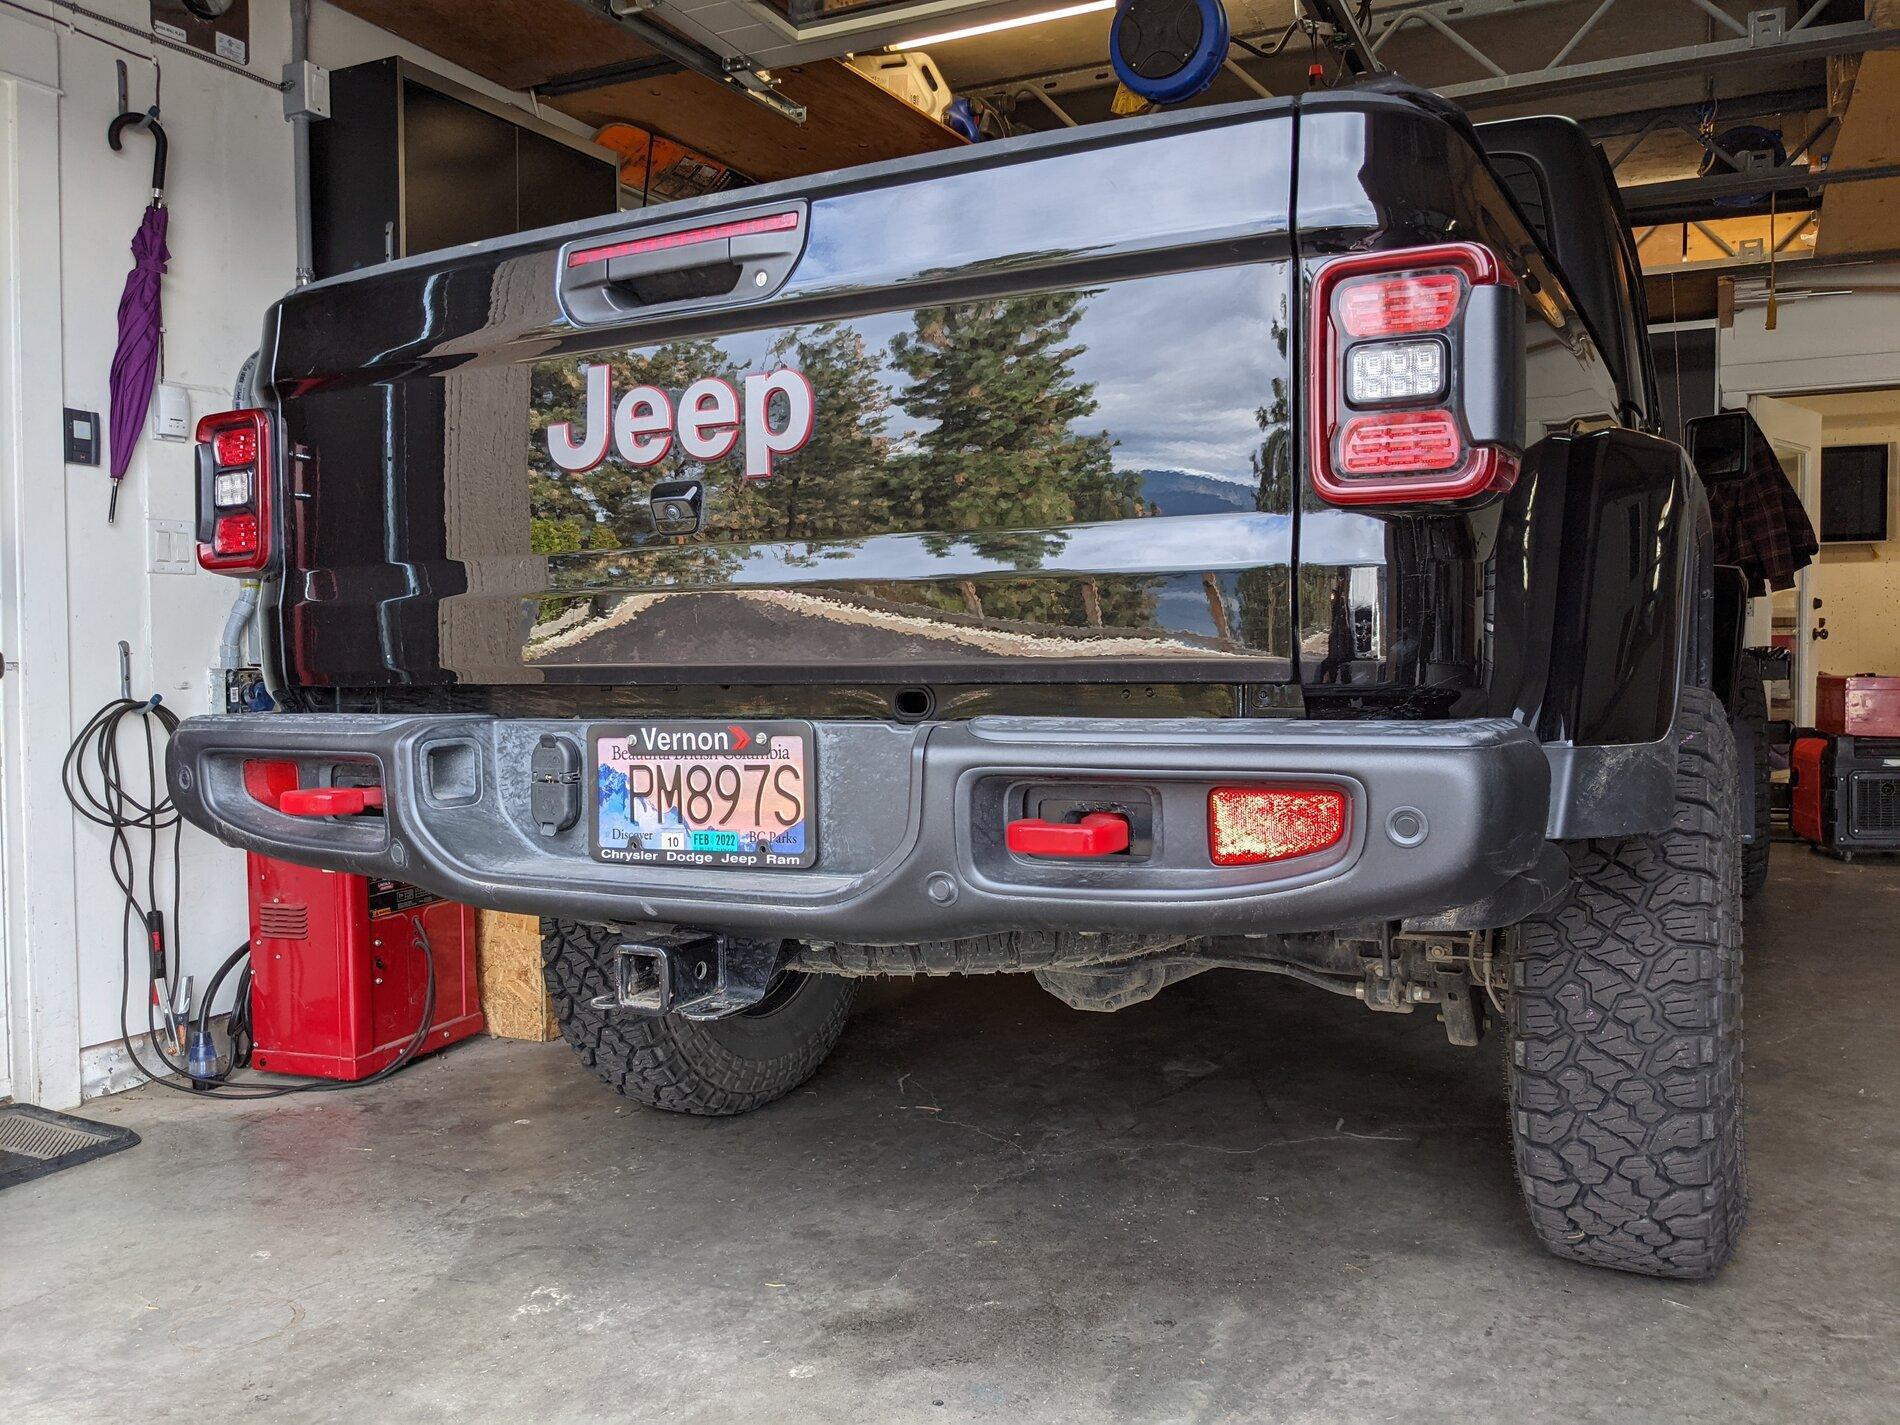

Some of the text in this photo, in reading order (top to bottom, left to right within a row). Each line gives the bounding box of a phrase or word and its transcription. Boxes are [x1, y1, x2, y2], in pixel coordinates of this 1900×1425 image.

[547, 363, 815, 480] Jeep
[641, 727, 729, 751] Vernon
[629, 764, 801, 827] PM897S
[667, 836, 679, 848] 10
[694, 833, 736, 847] FEB 2022
[749, 830, 798, 844] BC Parks
[601, 849, 800, 866] Chrysler Dodge Jeep Ram
